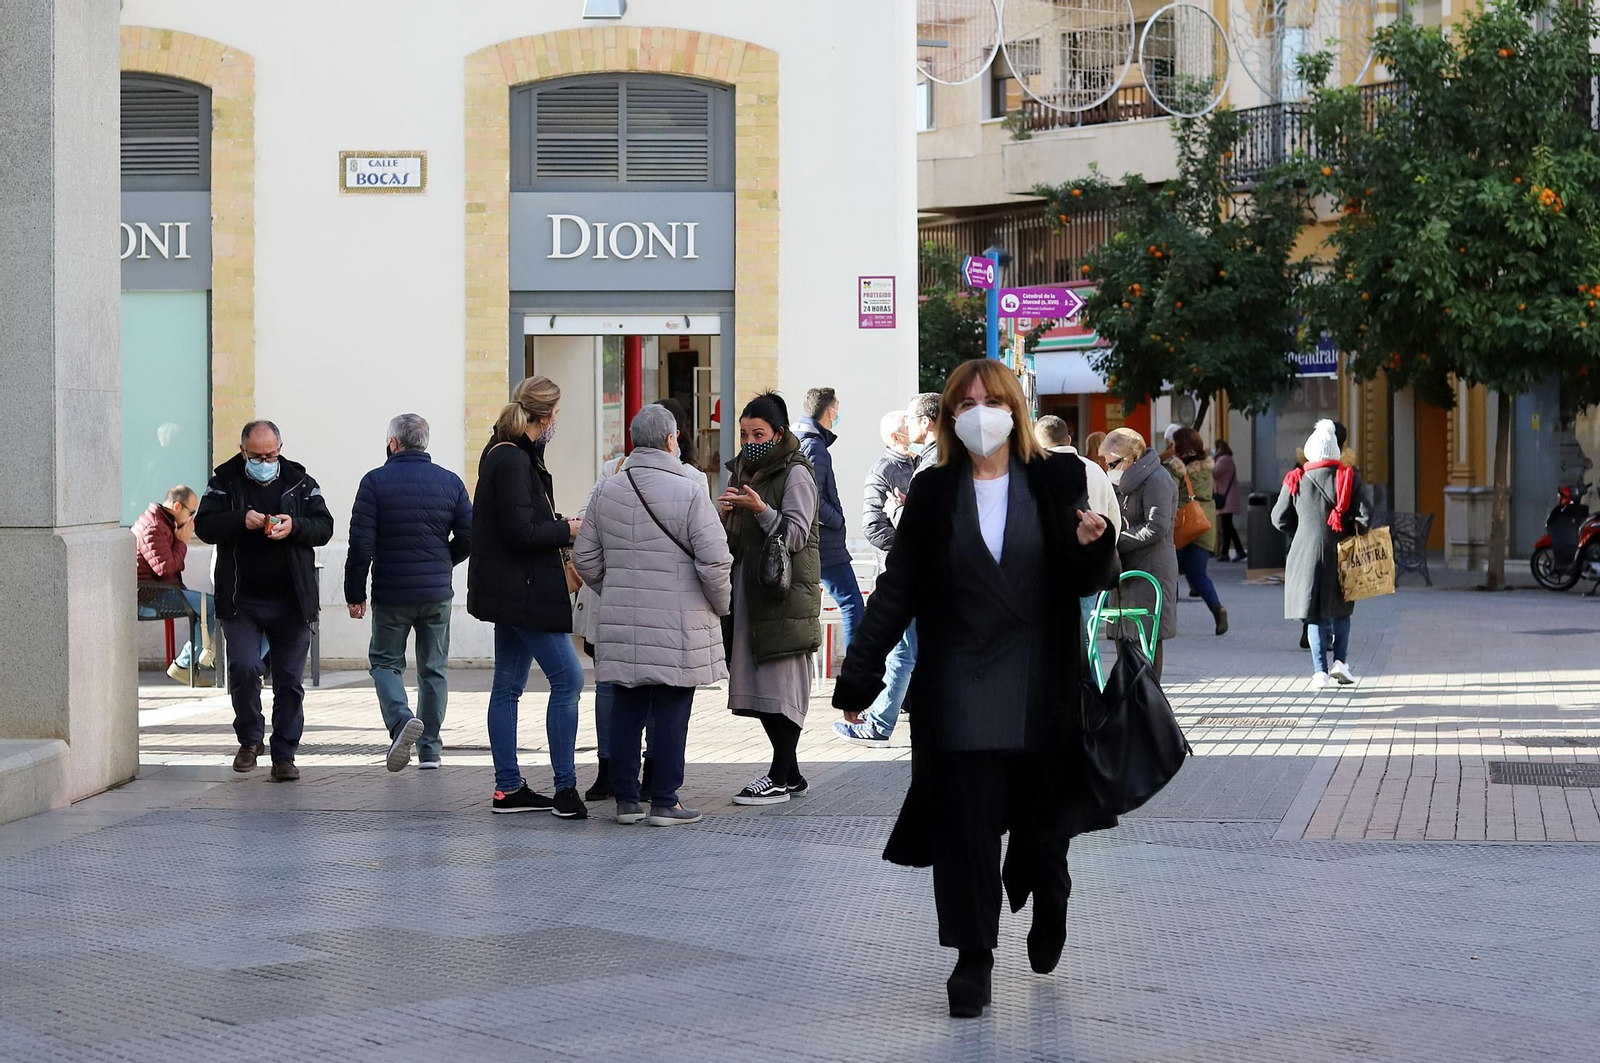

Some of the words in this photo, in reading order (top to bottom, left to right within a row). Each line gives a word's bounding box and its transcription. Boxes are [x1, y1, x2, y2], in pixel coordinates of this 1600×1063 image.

[368, 159, 399, 167] CALLE
[356, 173, 411, 185] BOCAS
[546, 214, 699, 260] DIONI
